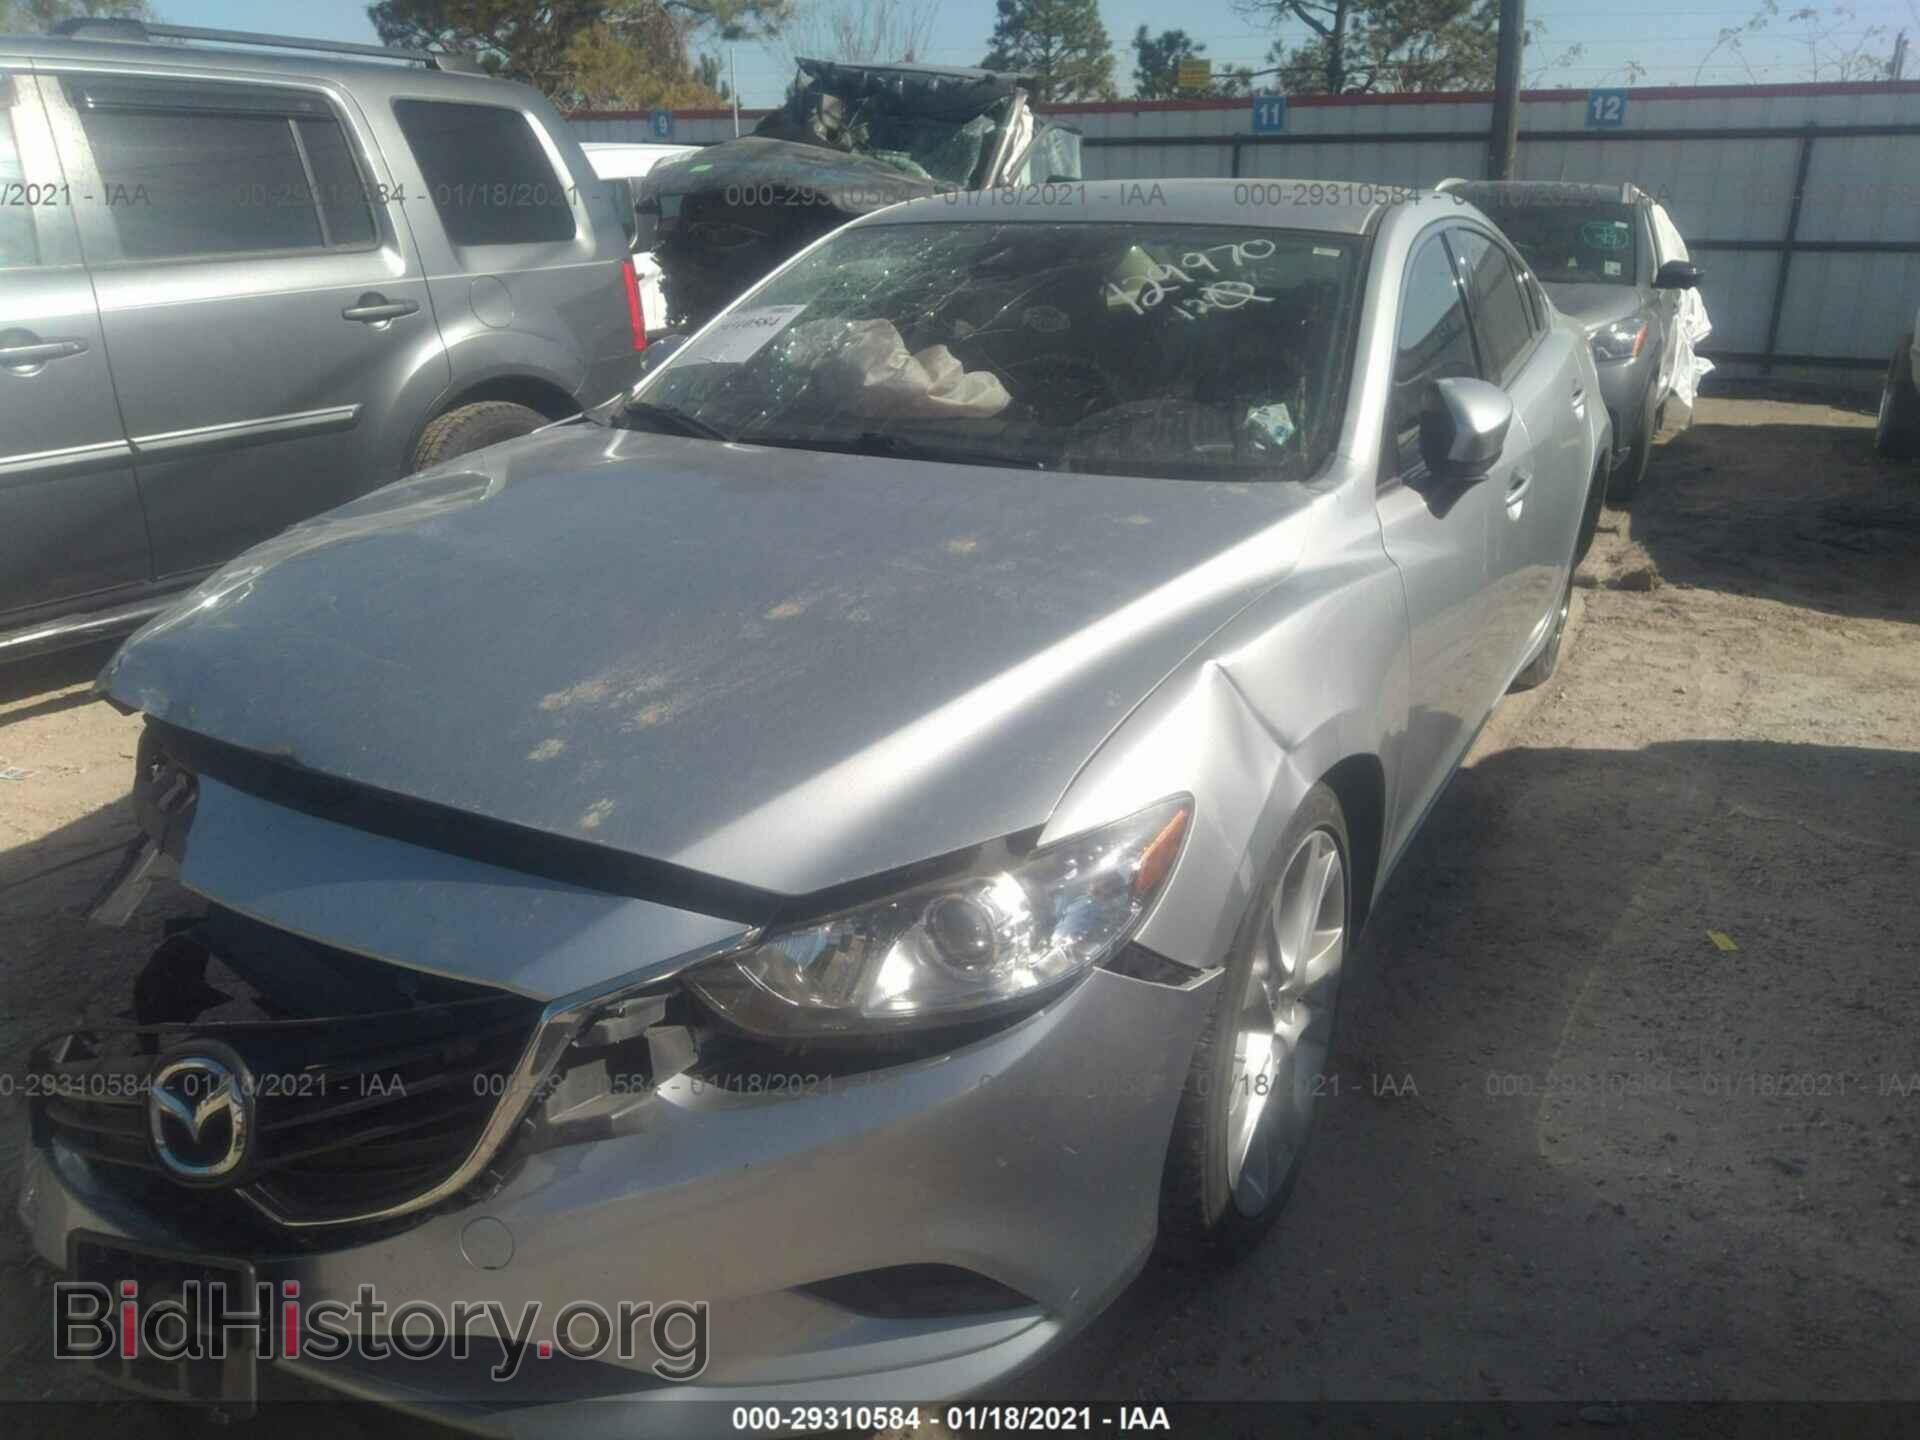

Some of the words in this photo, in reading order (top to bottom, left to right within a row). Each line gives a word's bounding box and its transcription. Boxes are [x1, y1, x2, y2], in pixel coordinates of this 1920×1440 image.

[1259, 103, 1280, 125] 11
[1593, 95, 1621, 120] 12
[658, 115, 668, 134] 9
